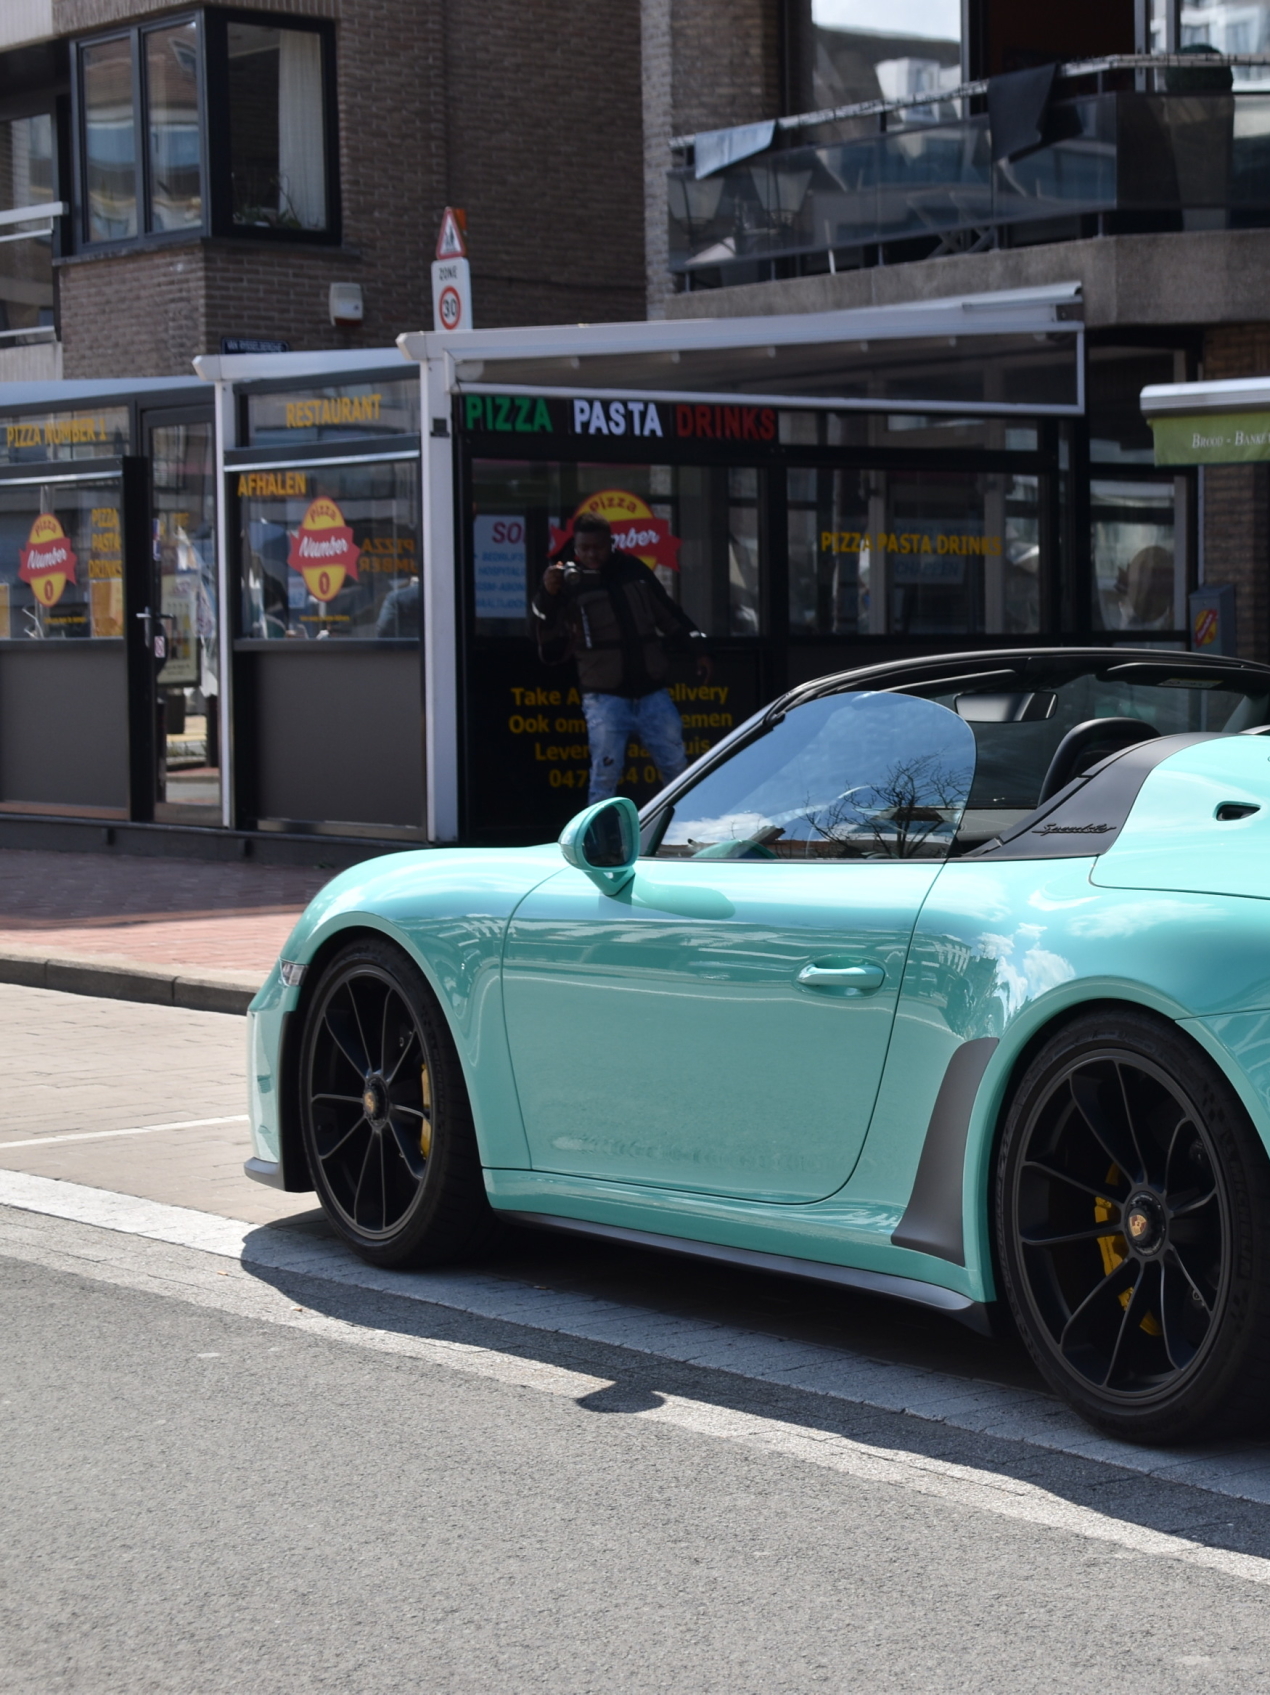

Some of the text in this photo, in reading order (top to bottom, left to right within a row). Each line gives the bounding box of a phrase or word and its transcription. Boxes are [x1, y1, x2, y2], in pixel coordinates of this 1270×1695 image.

[439, 266, 458, 281] ZONE
[443, 298, 457, 318] 30
[286, 393, 382, 428] RESTAURANT
[465, 394, 775, 440] PIZZA PASTA DRINKS
[6, 417, 107, 448] PIZZA NUMBER 1
[237, 472, 306, 497] AFHALEN
[299, 535, 349, 558] Number
[610, 527, 660, 553] mber
[821, 531, 1003, 556] PIZZA PASTA DRINKS
[27, 545, 68, 570] Number
[510, 687, 561, 706] Take
[668, 683, 728, 705] elivery
[509, 713, 550, 734] Ook
